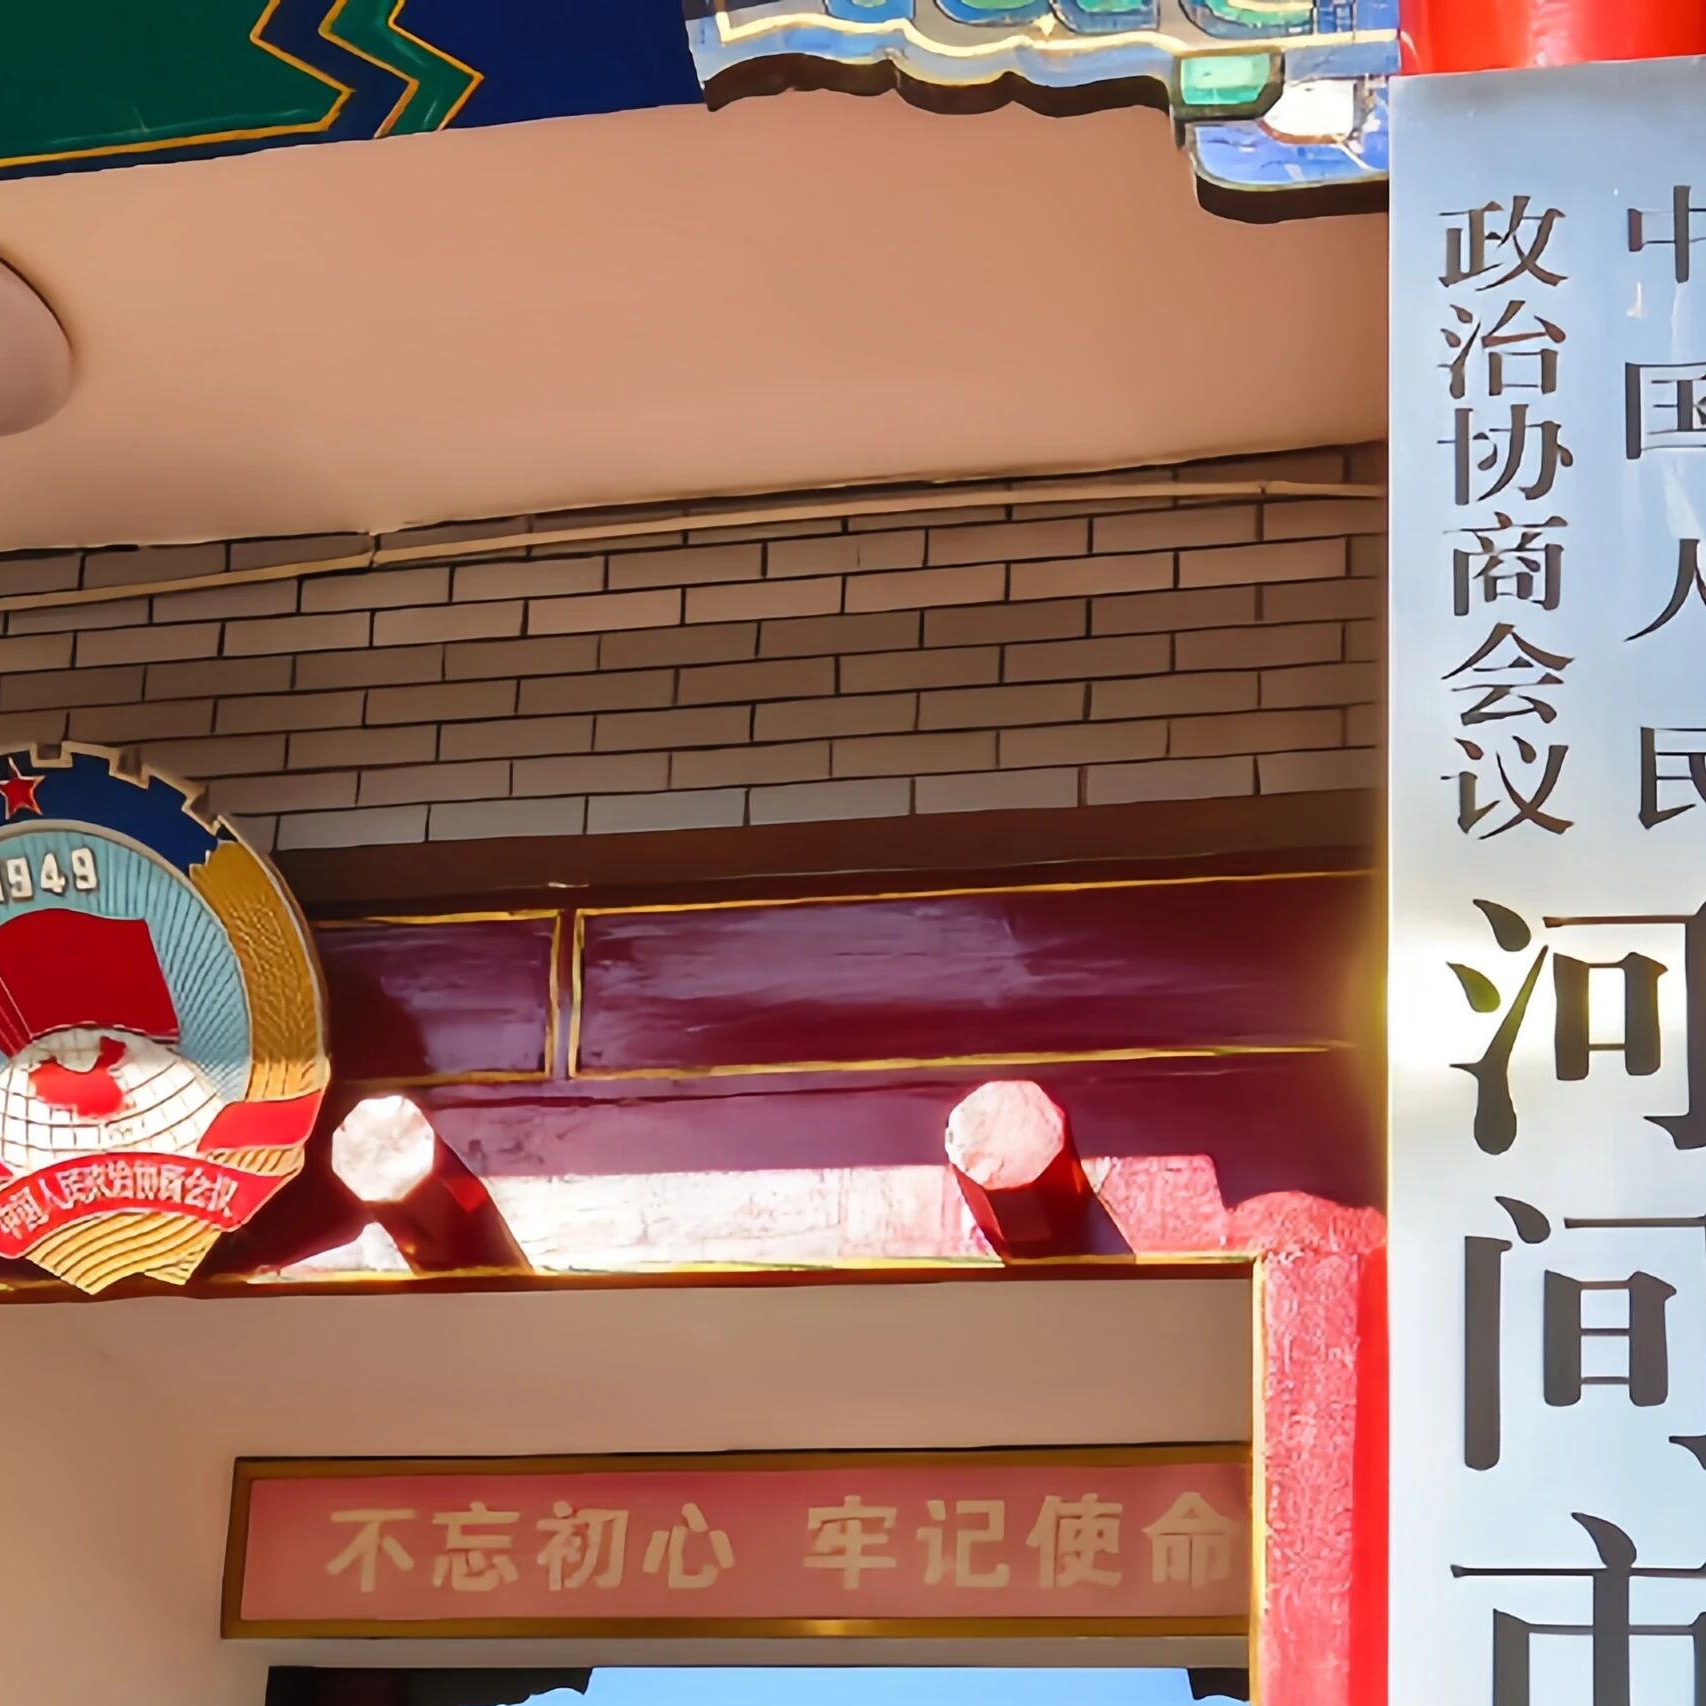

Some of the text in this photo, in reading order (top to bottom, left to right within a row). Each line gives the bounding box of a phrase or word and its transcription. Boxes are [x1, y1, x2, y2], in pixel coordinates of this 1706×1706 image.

[1436, 194, 1576, 841] 政治协商会议
[326, 1491, 1241, 1592] 不忘初心 牢记使命
